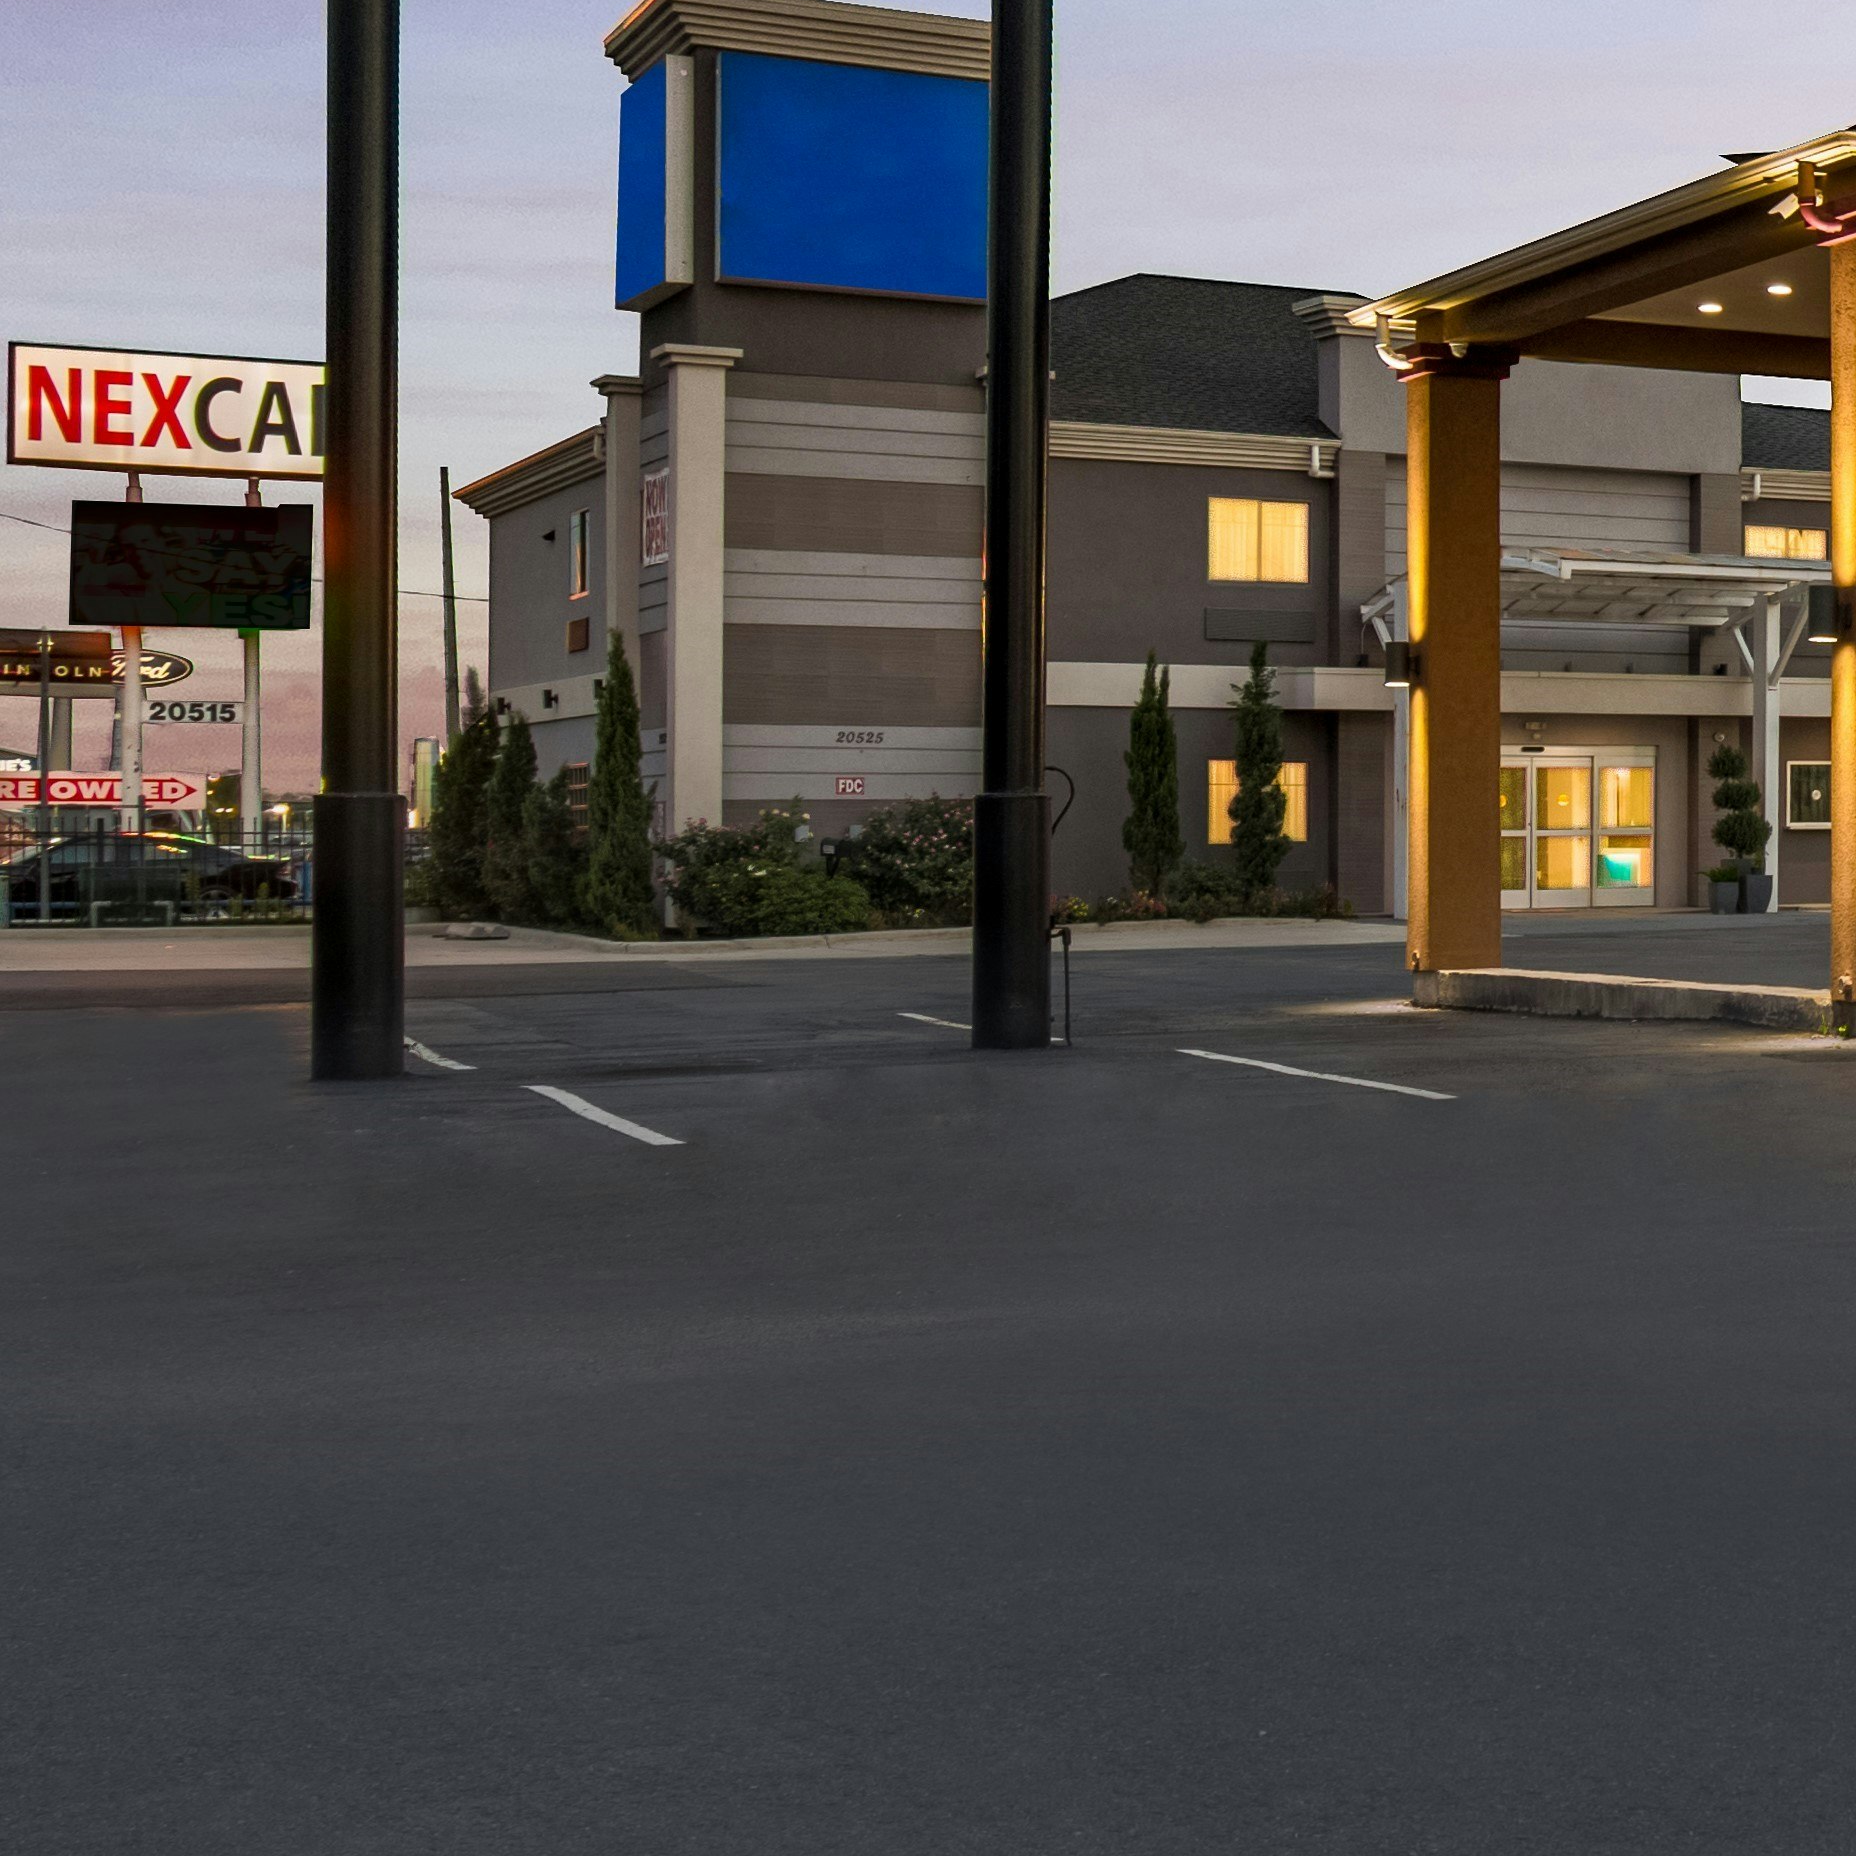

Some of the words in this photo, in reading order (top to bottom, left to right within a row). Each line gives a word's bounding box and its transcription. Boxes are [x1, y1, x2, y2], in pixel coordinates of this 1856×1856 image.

[27, 364, 326, 457] NEXCA
[3, 664, 102, 677] INOLN
[110, 654, 172, 679] Frd
[149, 702, 236, 722] 20515
[835, 731, 884, 744] 20525
[838, 778, 863, 793] FDC
